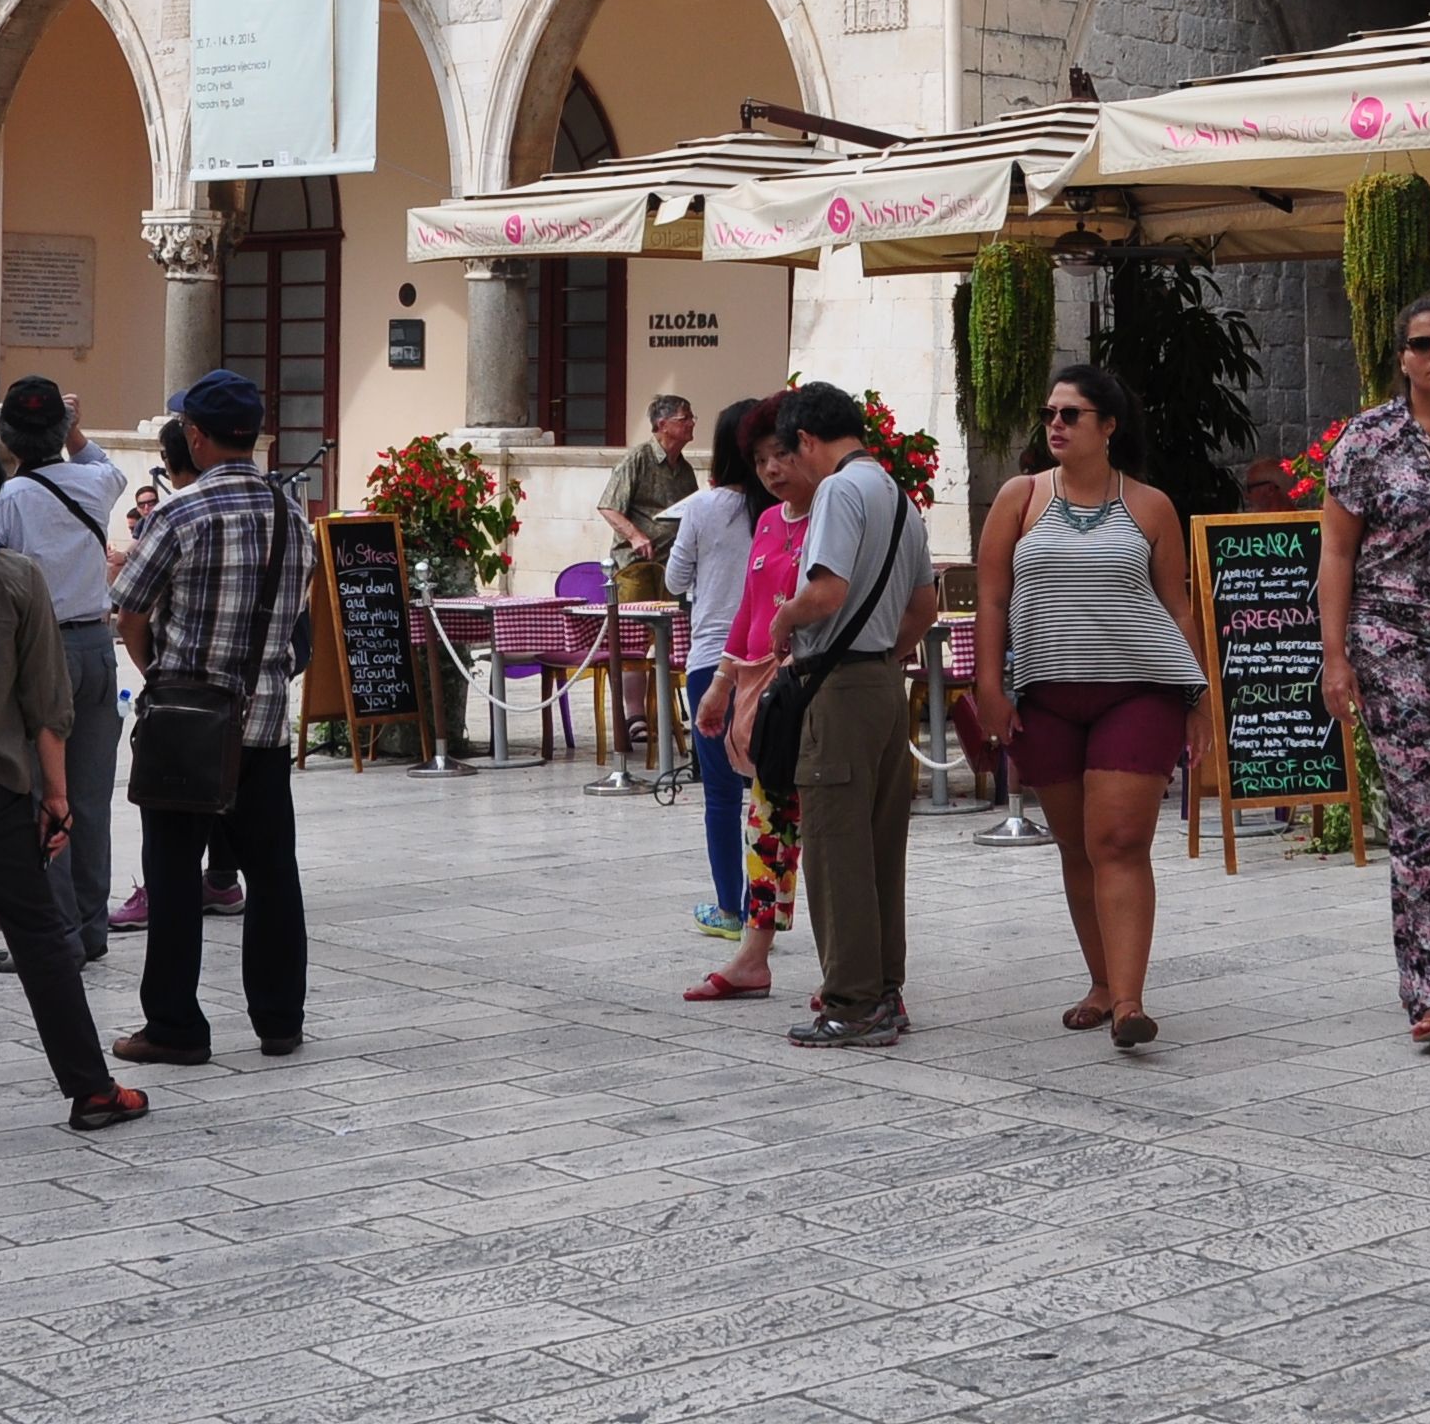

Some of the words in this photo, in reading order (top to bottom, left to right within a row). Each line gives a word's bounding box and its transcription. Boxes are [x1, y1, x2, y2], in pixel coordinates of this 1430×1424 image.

[1265, 115, 1330, 143] Bistro
[938, 192, 989, 221] Bistro
[649, 310, 719, 330] IZLOŽBA
[649, 334, 719, 348] EXHIBITION
[336, 539, 354, 568] No
[354, 543, 398, 565] Stress
[338, 581, 364, 596] Slow
[365, 577, 395, 596] down
[345, 596, 368, 609] and
[348, 607, 400, 629] everything
[343, 627, 364, 644] you
[366, 627, 385, 638] are
[355, 638, 400, 657] chasing
[347, 650, 370, 666] will
[372, 653, 403, 665] come
[354, 666, 397, 680] around
[351, 680, 373, 694] and
[377, 680, 410, 694] catch
[1251, 748, 1289, 758] SAUCE
[1228, 758, 1274, 776] PART
[1275, 758, 1299, 774] OF
[1303, 754, 1343, 772] OUR
